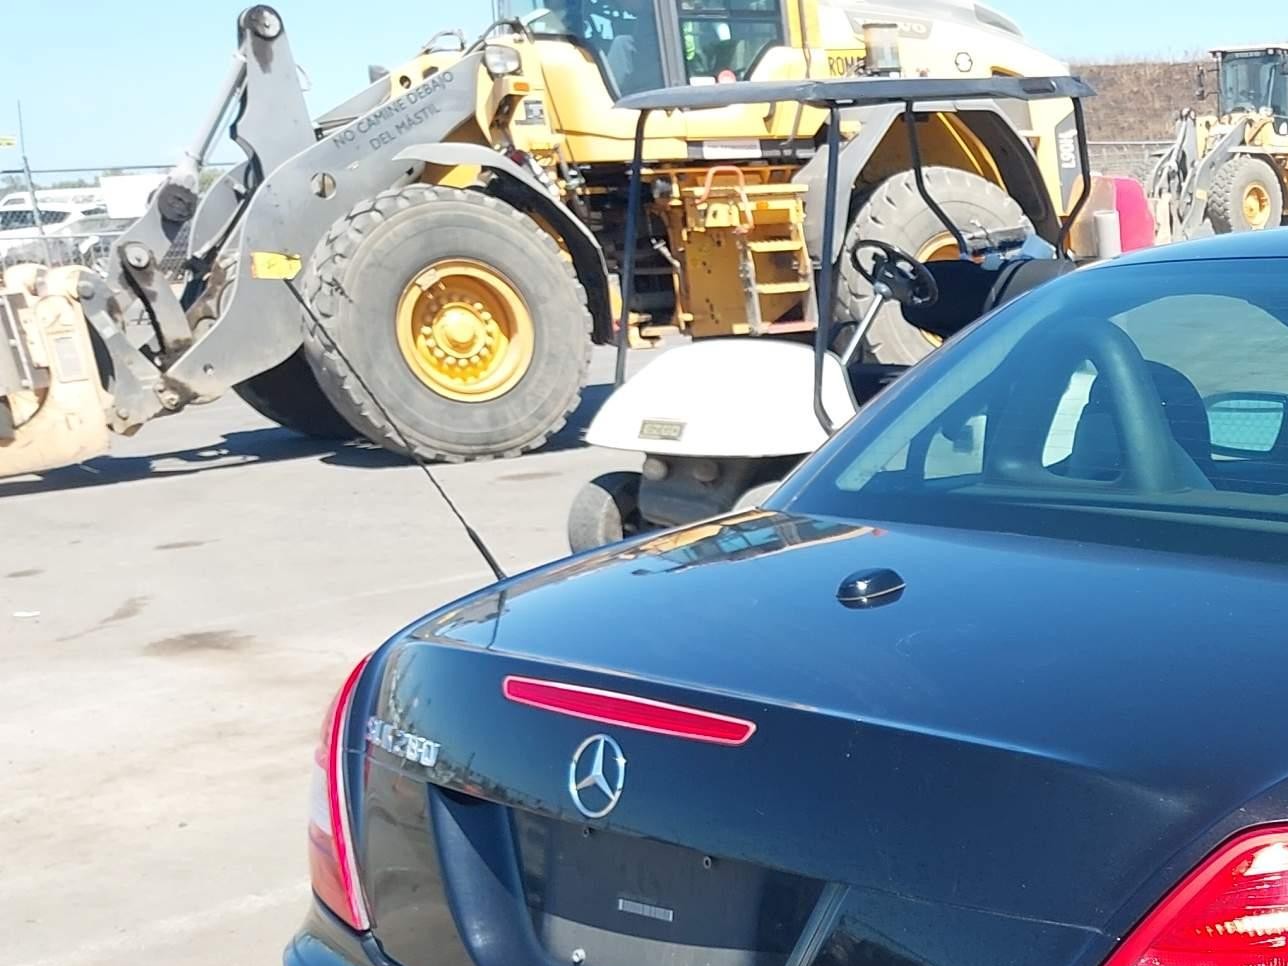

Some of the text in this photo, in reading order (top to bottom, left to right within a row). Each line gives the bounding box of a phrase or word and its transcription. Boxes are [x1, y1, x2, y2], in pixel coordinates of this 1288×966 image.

[332, 71, 455, 150] NO CAMINE DEBAJO
[369, 130, 397, 151] DEL
